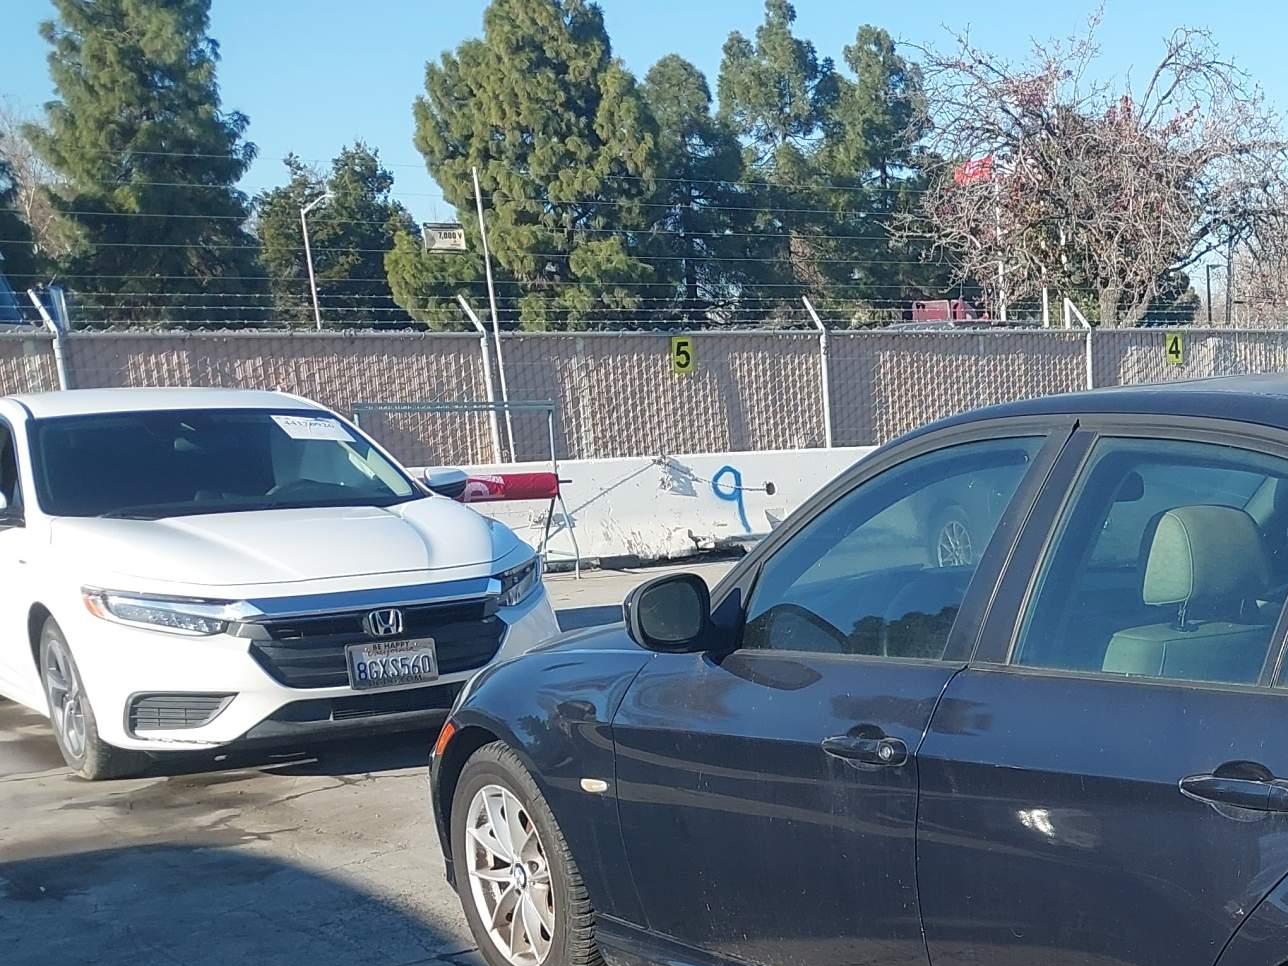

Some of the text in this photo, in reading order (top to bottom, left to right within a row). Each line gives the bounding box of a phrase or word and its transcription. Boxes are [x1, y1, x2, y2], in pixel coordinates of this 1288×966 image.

[675, 341, 691, 369] 5
[1168, 335, 1181, 360] 4
[356, 655, 431, 681] 8GXS560
